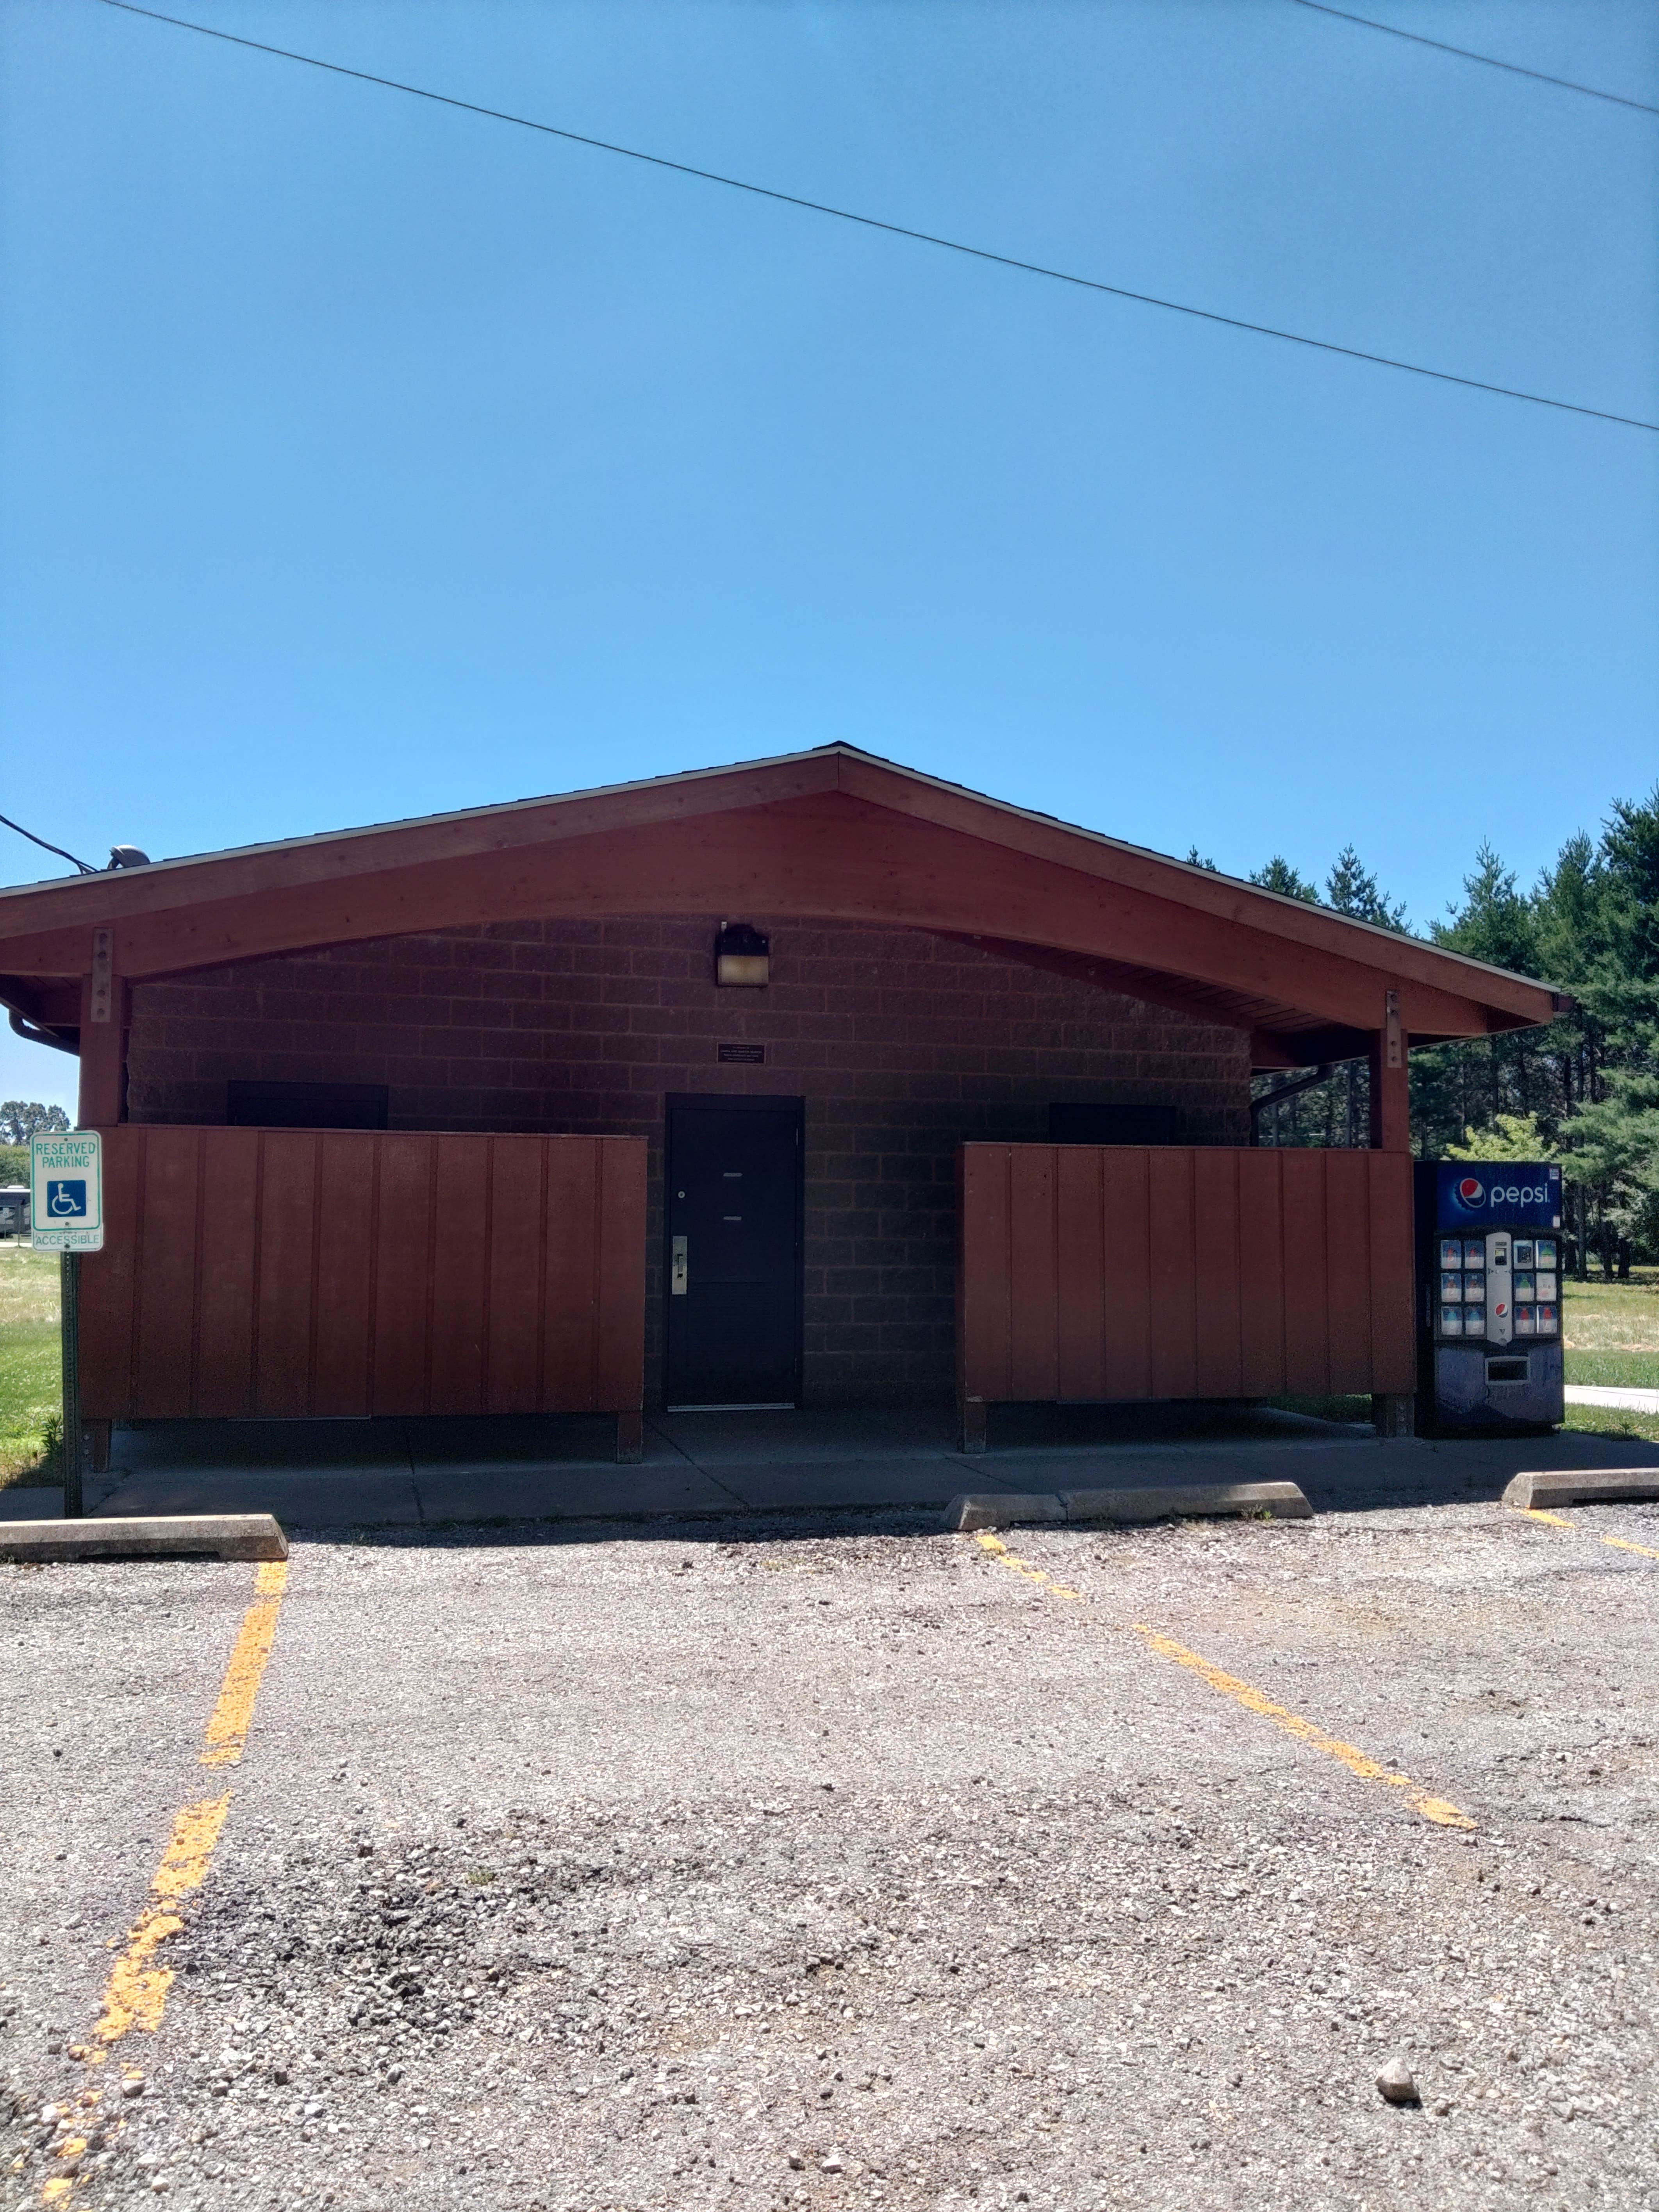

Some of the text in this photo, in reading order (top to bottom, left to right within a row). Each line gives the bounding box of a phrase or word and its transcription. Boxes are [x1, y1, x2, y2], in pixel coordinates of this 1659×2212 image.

[36, 1142, 96, 1155] RESERVED
[42, 1156, 89, 1168] PARKING
[1491, 1183, 1548, 1208] pepsi
[36, 1234, 99, 1245] ACCESSIBLE
